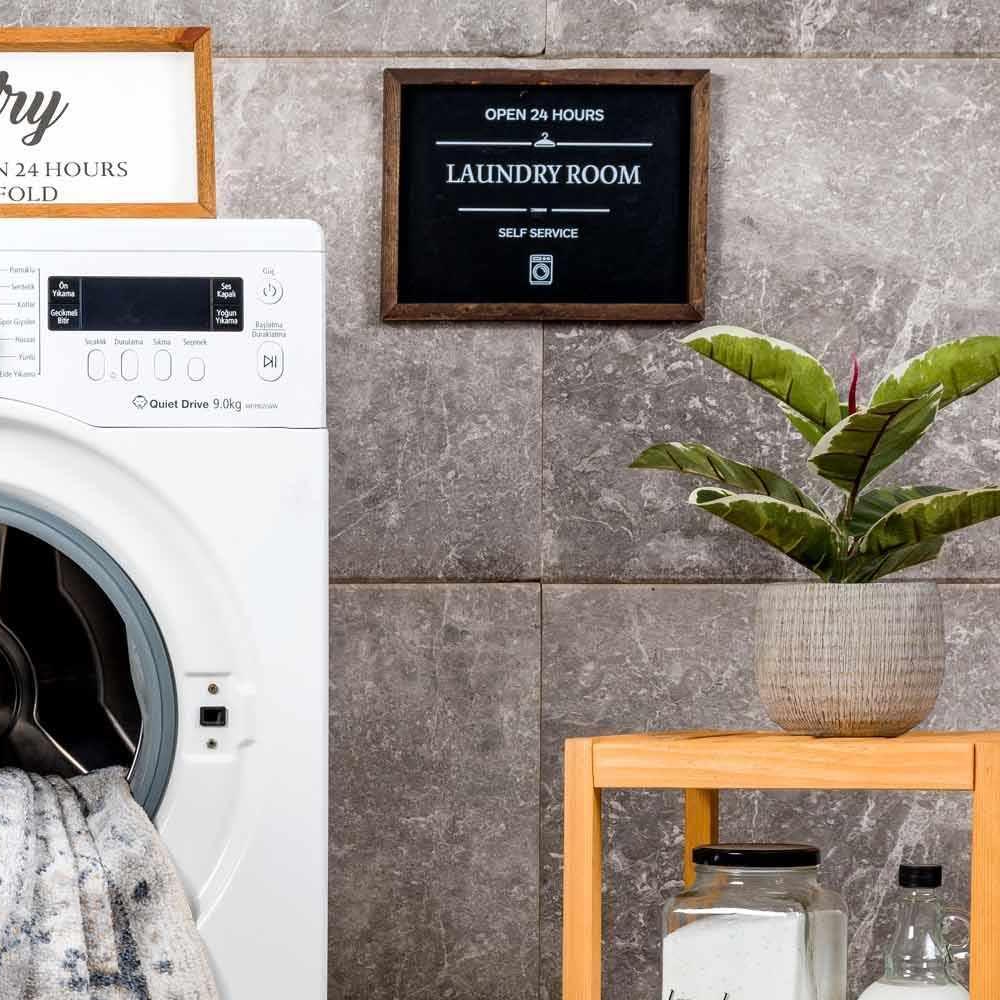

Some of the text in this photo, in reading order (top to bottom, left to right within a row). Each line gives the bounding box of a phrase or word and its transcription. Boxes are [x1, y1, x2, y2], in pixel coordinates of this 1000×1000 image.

[485, 108, 605, 122] OPEN 24 HOURS
[15, 162, 40, 178] 24
[45, 161, 128, 178] HOURS
[446, 163, 642, 185] LAUNDRY ROOM
[498, 227, 579, 239] SELF SERVICE
[149, 399, 179, 409] Quiet
[181, 399, 210, 409] Drive
[212, 397, 242, 412] 9.0kg
